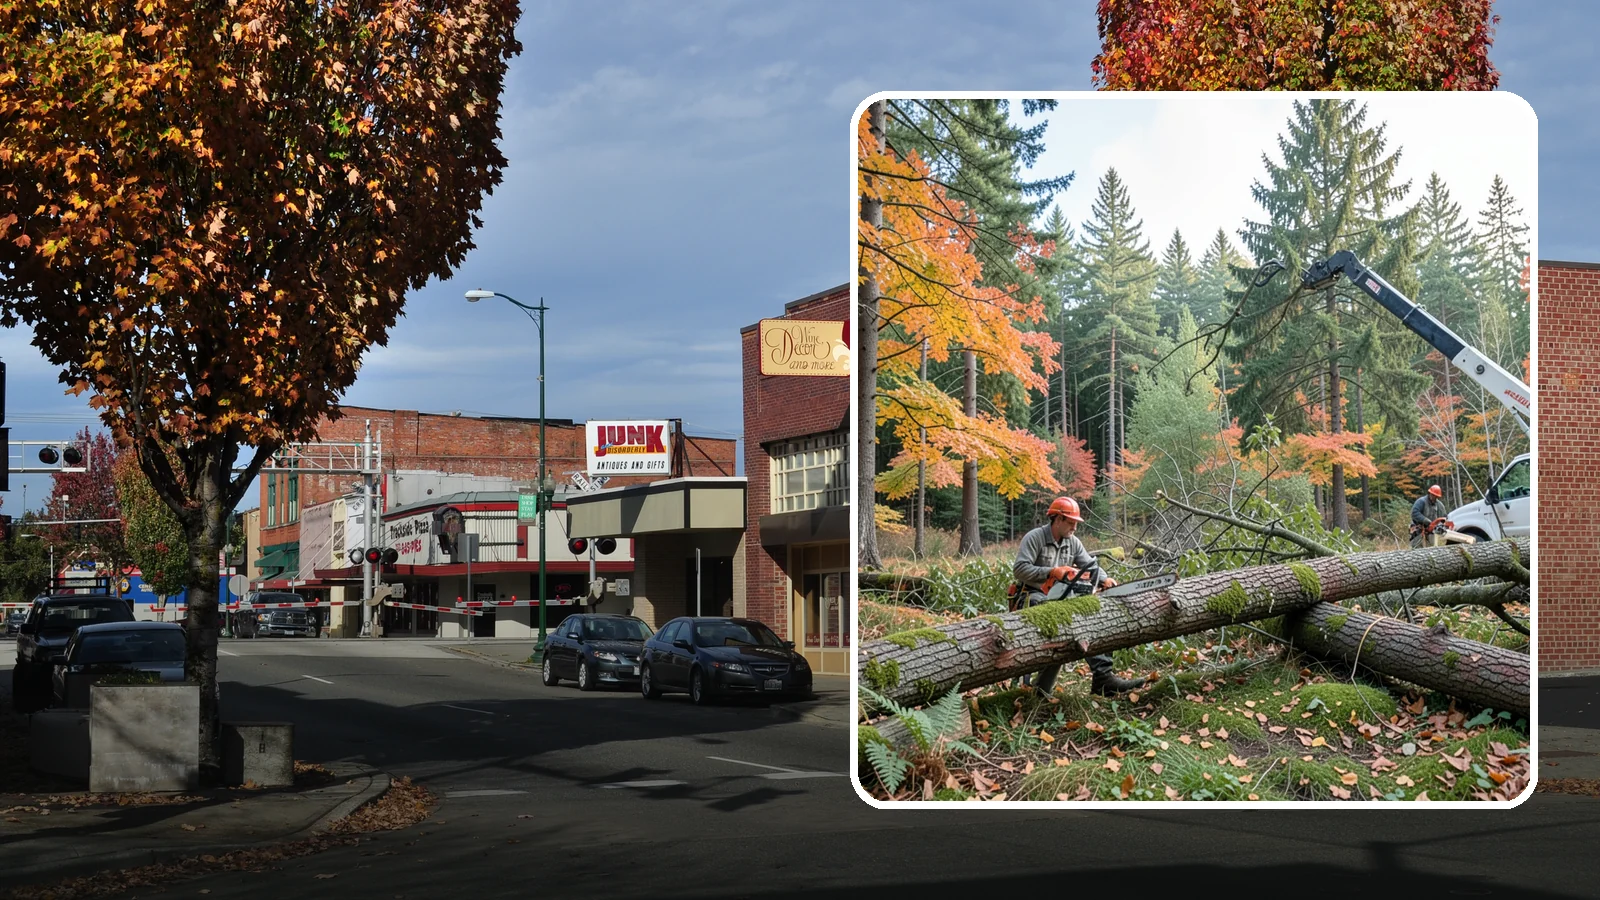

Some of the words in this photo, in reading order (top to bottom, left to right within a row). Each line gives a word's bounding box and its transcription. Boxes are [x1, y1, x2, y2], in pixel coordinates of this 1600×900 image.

[595, 425, 665, 457] JUNK
[607, 446, 646, 454] DISORDERLY
[597, 461, 628, 470] ANTIQUES
[631, 461, 644, 470] AND
[647, 461, 665, 470] GIFTS
[414, 519, 429, 534] Pizza
